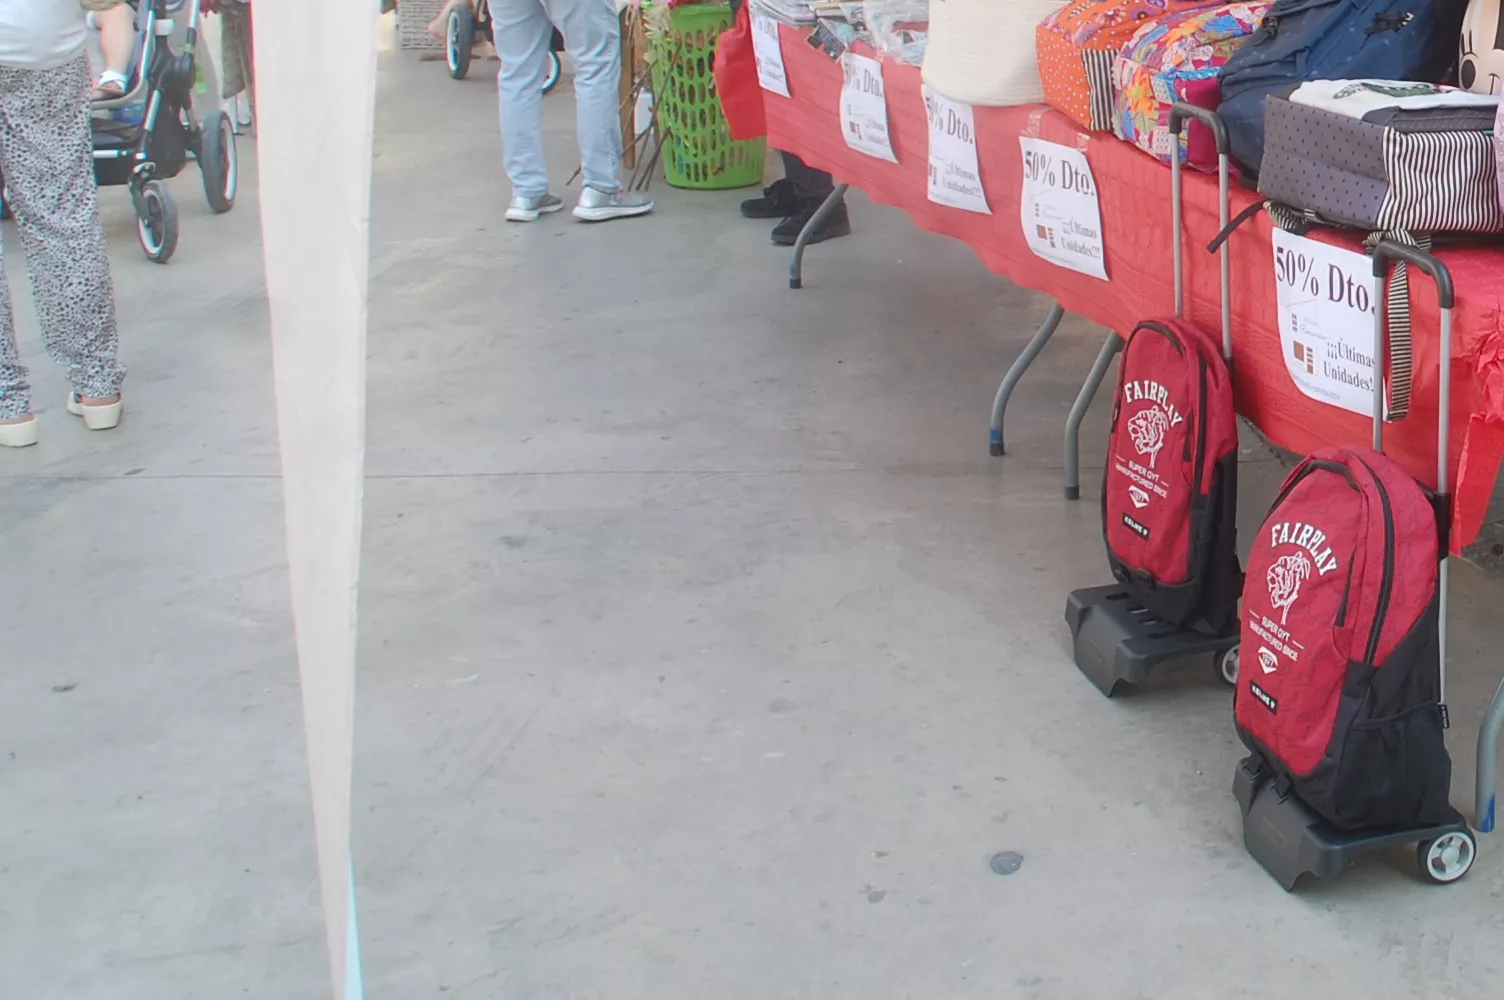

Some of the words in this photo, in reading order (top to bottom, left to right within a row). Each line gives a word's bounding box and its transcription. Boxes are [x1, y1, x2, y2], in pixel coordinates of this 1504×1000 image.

[863, 68, 884, 98] Dto.
[947, 108, 974, 145] Dto.
[1025, 150, 1056, 188] 50%
[1061, 159, 1095, 197] Dto.
[1276, 246, 1319, 297] 50%
[1323, 360, 1375, 392] Unidades!
[1124, 379, 1183, 428] FAIRPLAY
[1271, 521, 1338, 577] FAIRPLAY
